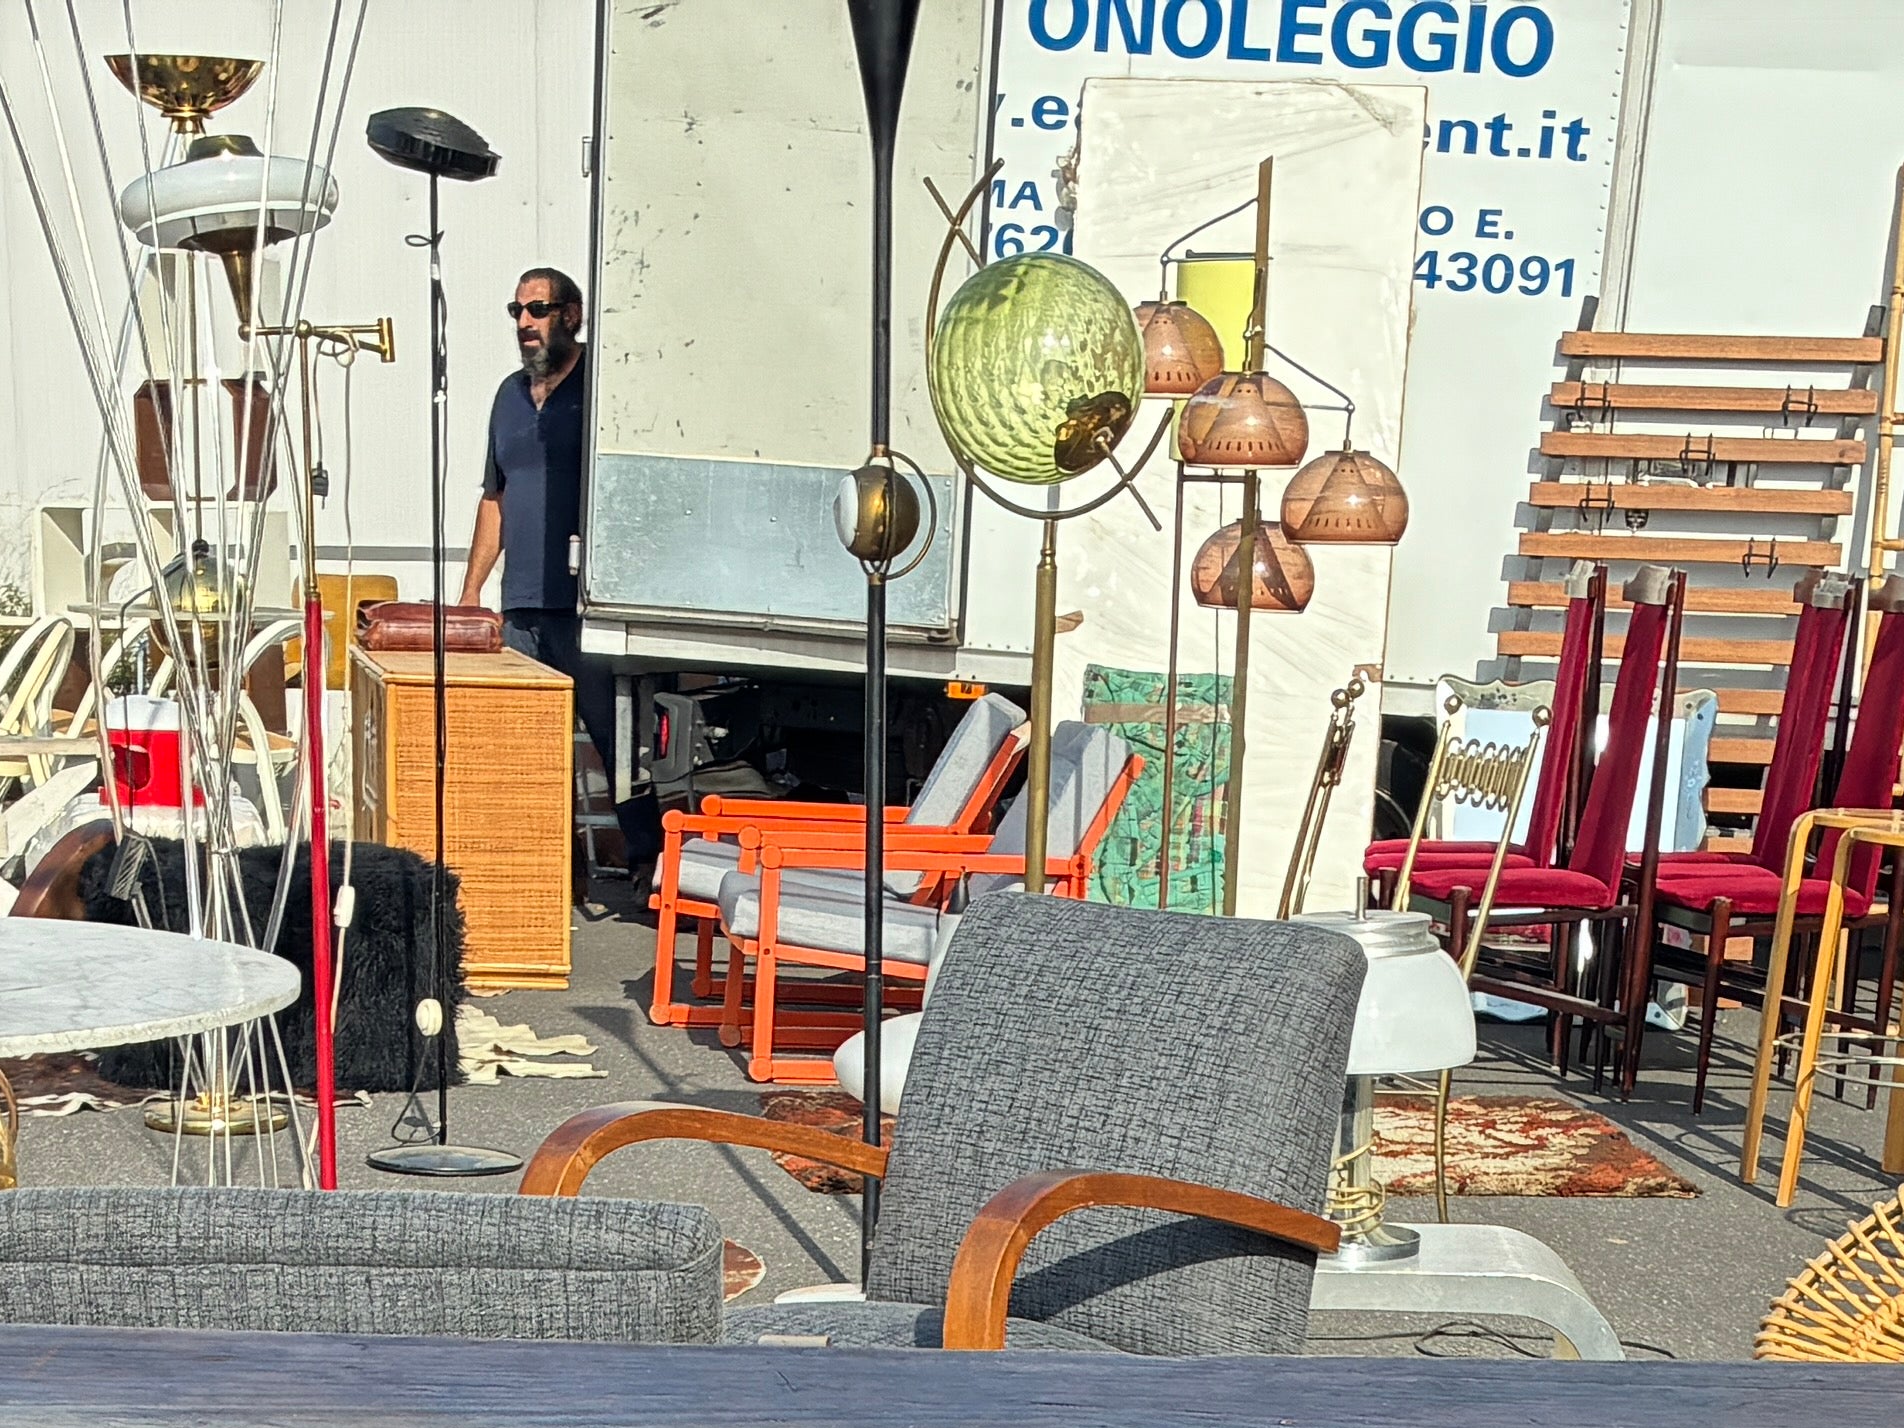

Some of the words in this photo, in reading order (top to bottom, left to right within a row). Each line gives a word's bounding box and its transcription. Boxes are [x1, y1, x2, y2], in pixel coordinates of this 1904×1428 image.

[1028, 0, 1555, 77] ONOLEGGIO
[1475, 209, 1514, 240] E.
[1413, 250, 1576, 298] 43091
